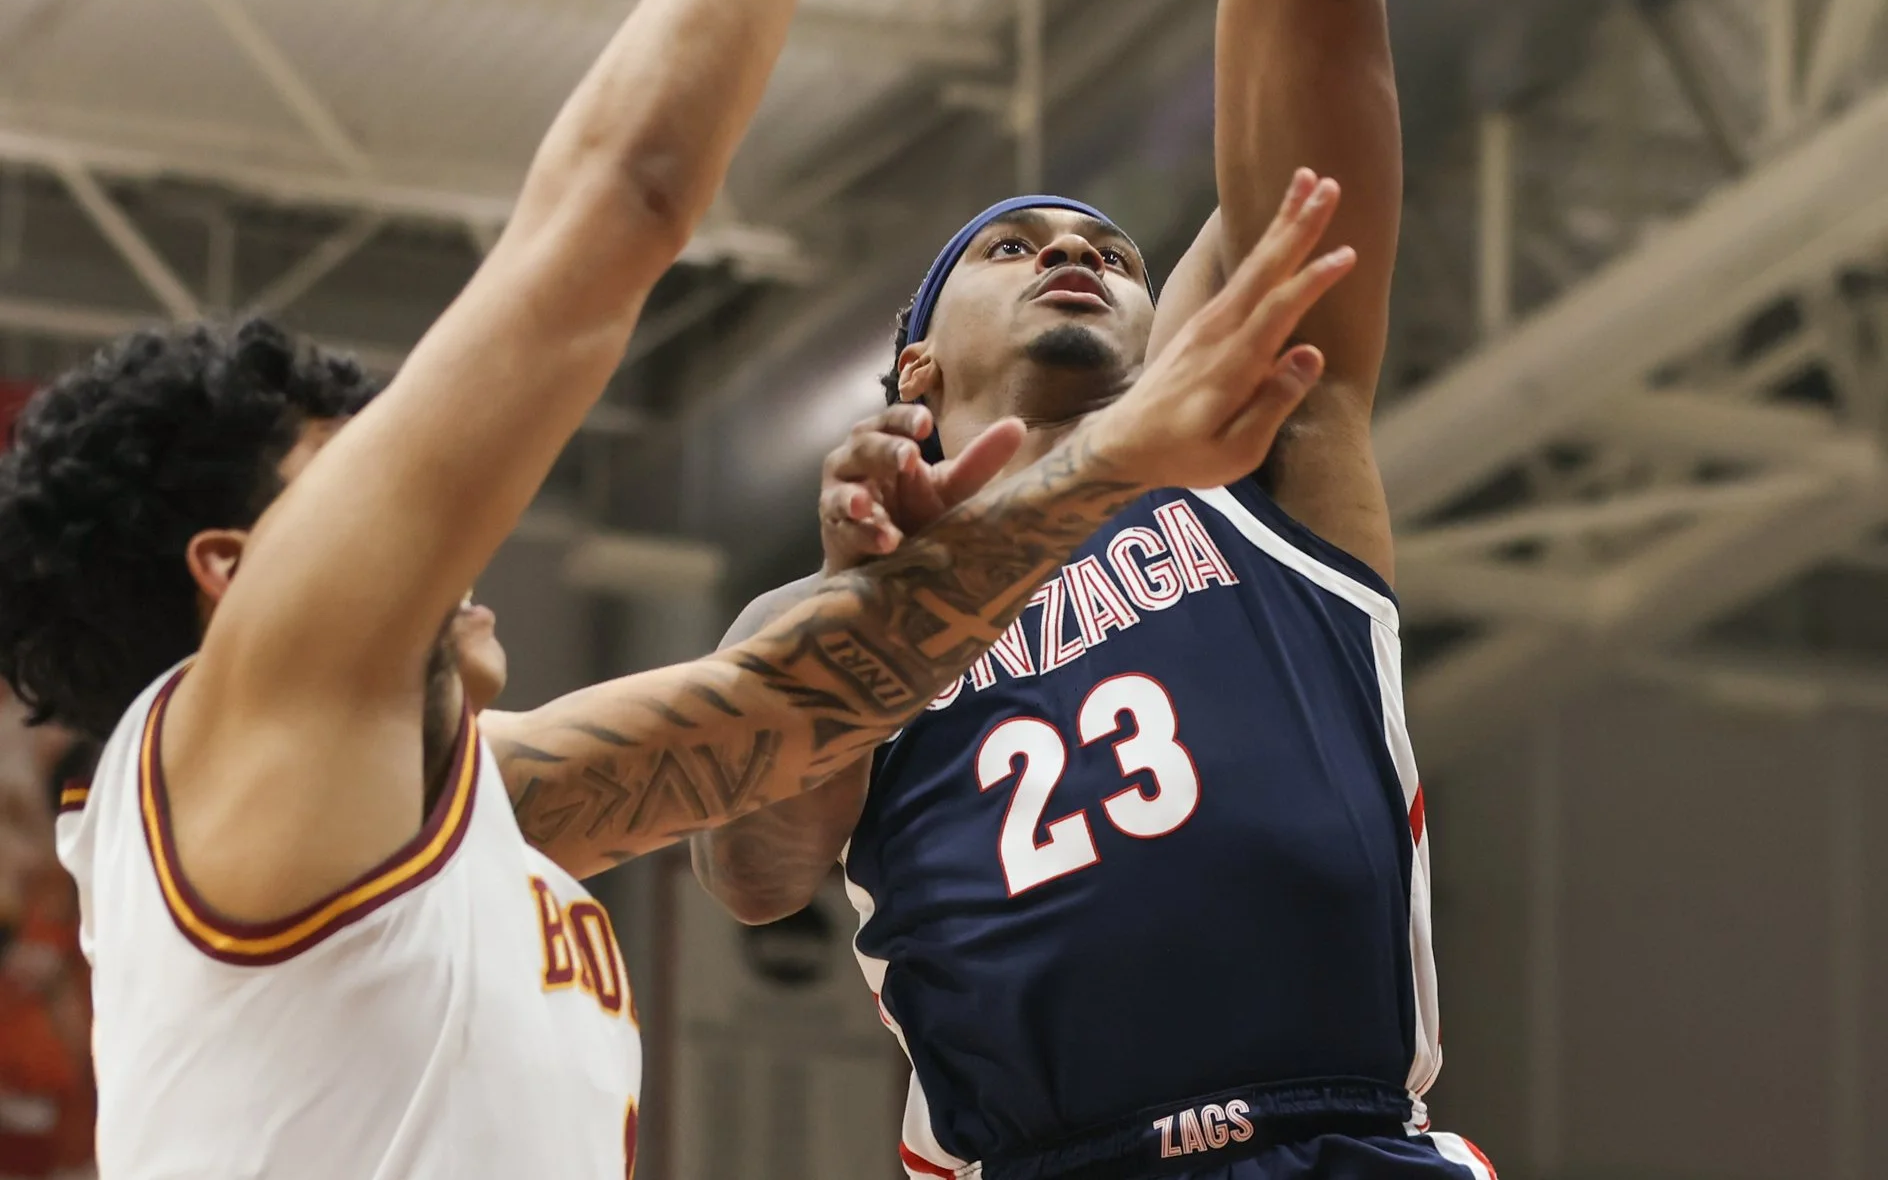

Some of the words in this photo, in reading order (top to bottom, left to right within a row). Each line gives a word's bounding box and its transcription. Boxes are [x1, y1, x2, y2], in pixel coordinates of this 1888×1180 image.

[926, 499, 1239, 711] NZAGA
[974, 672, 1200, 898] 23
[1153, 1099, 1254, 1158] ZAGS
